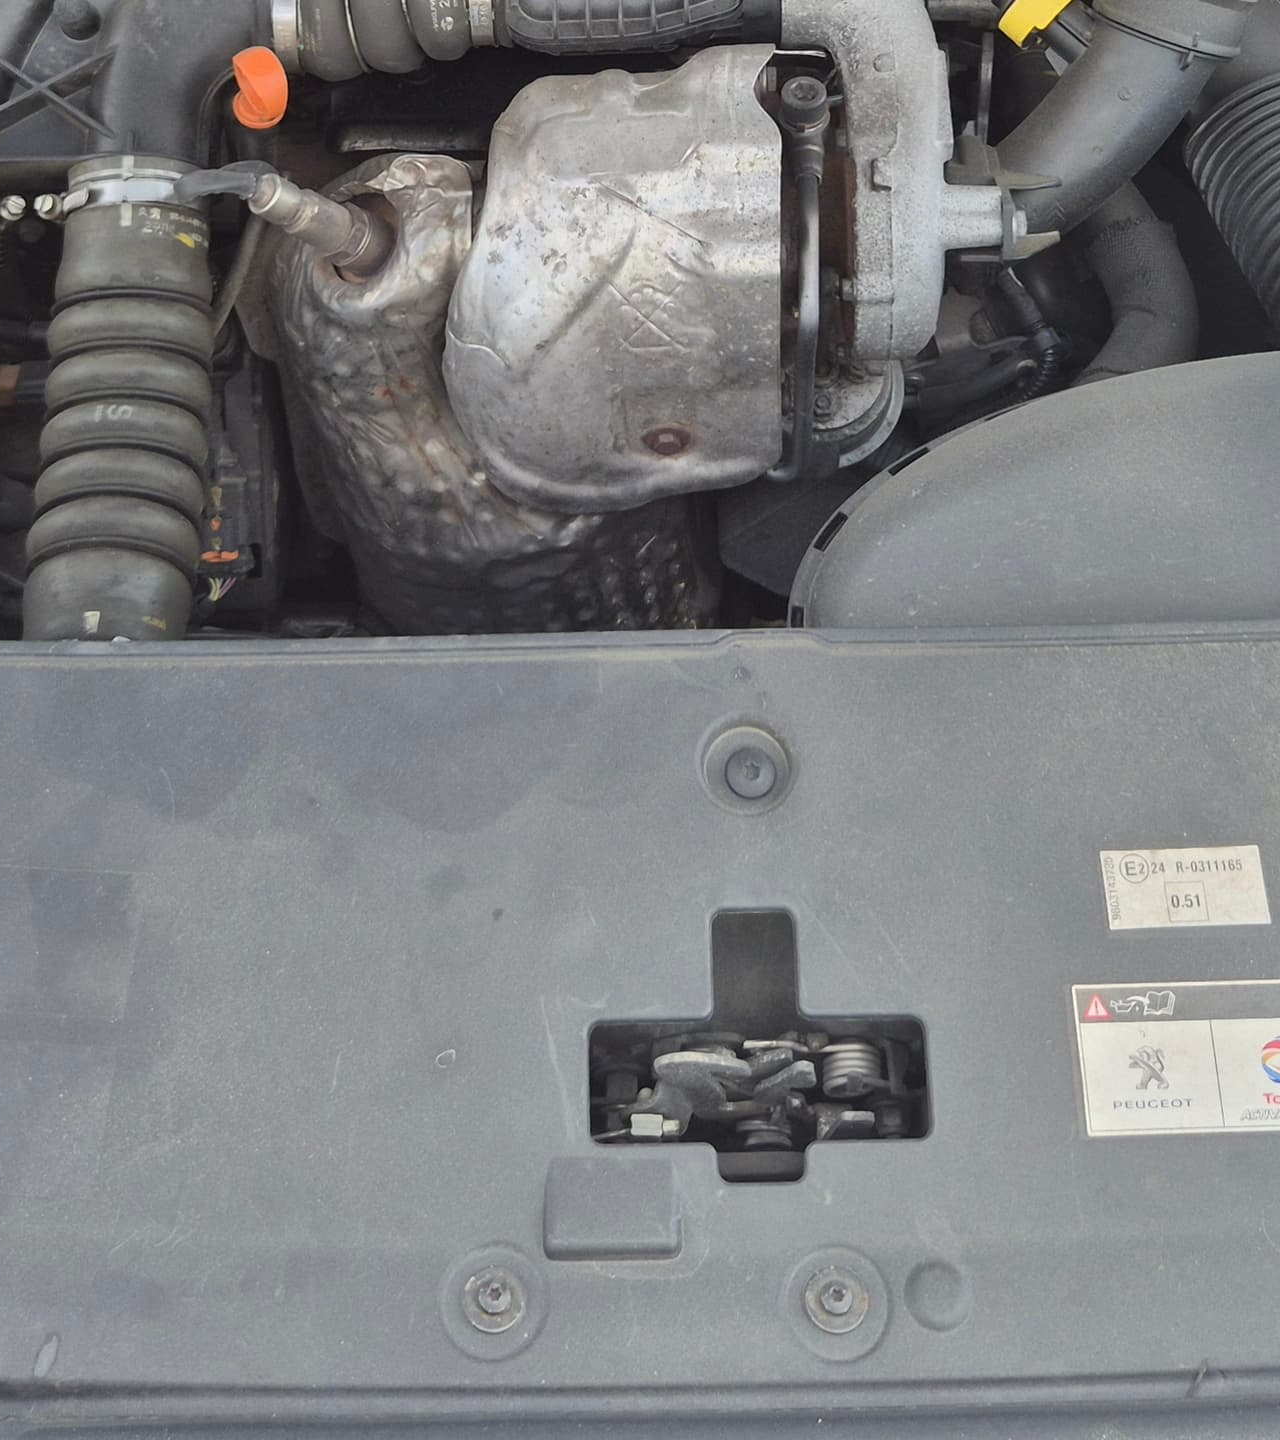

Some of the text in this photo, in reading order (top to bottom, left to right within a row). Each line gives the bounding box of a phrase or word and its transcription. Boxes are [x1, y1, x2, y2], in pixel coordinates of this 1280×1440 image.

[1151, 861, 1166, 875] 24
[1175, 858, 1243, 874] R-0311165
[1170, 893, 1202, 909] 0.51
[1112, 1098, 1194, 1110] PEUGEOT
